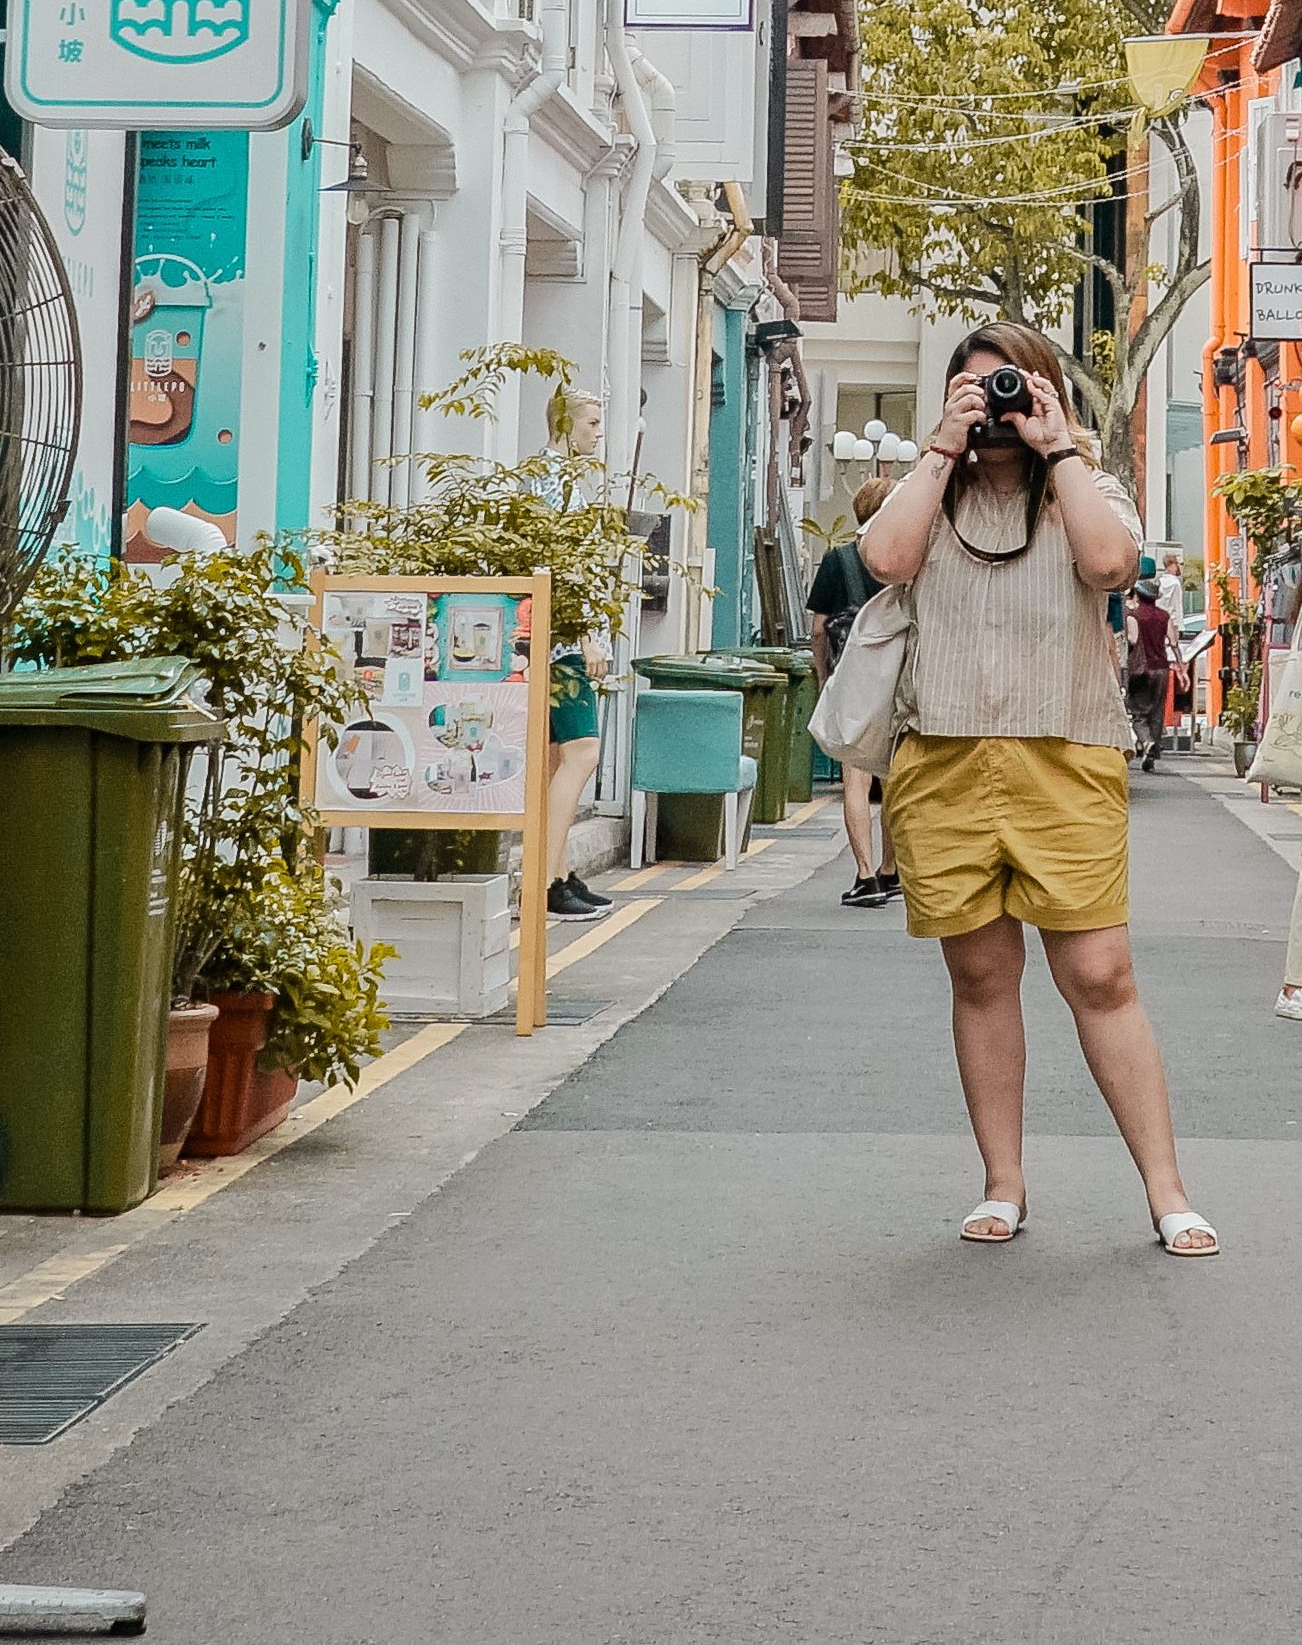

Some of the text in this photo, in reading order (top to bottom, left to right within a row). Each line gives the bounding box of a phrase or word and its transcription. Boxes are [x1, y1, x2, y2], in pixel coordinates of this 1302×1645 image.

[58, 2, 86, 63] 小坡
[186, 137, 211, 150] milk
[182, 154, 217, 168] heart
[131, 381, 185, 392] LITTLEPO
